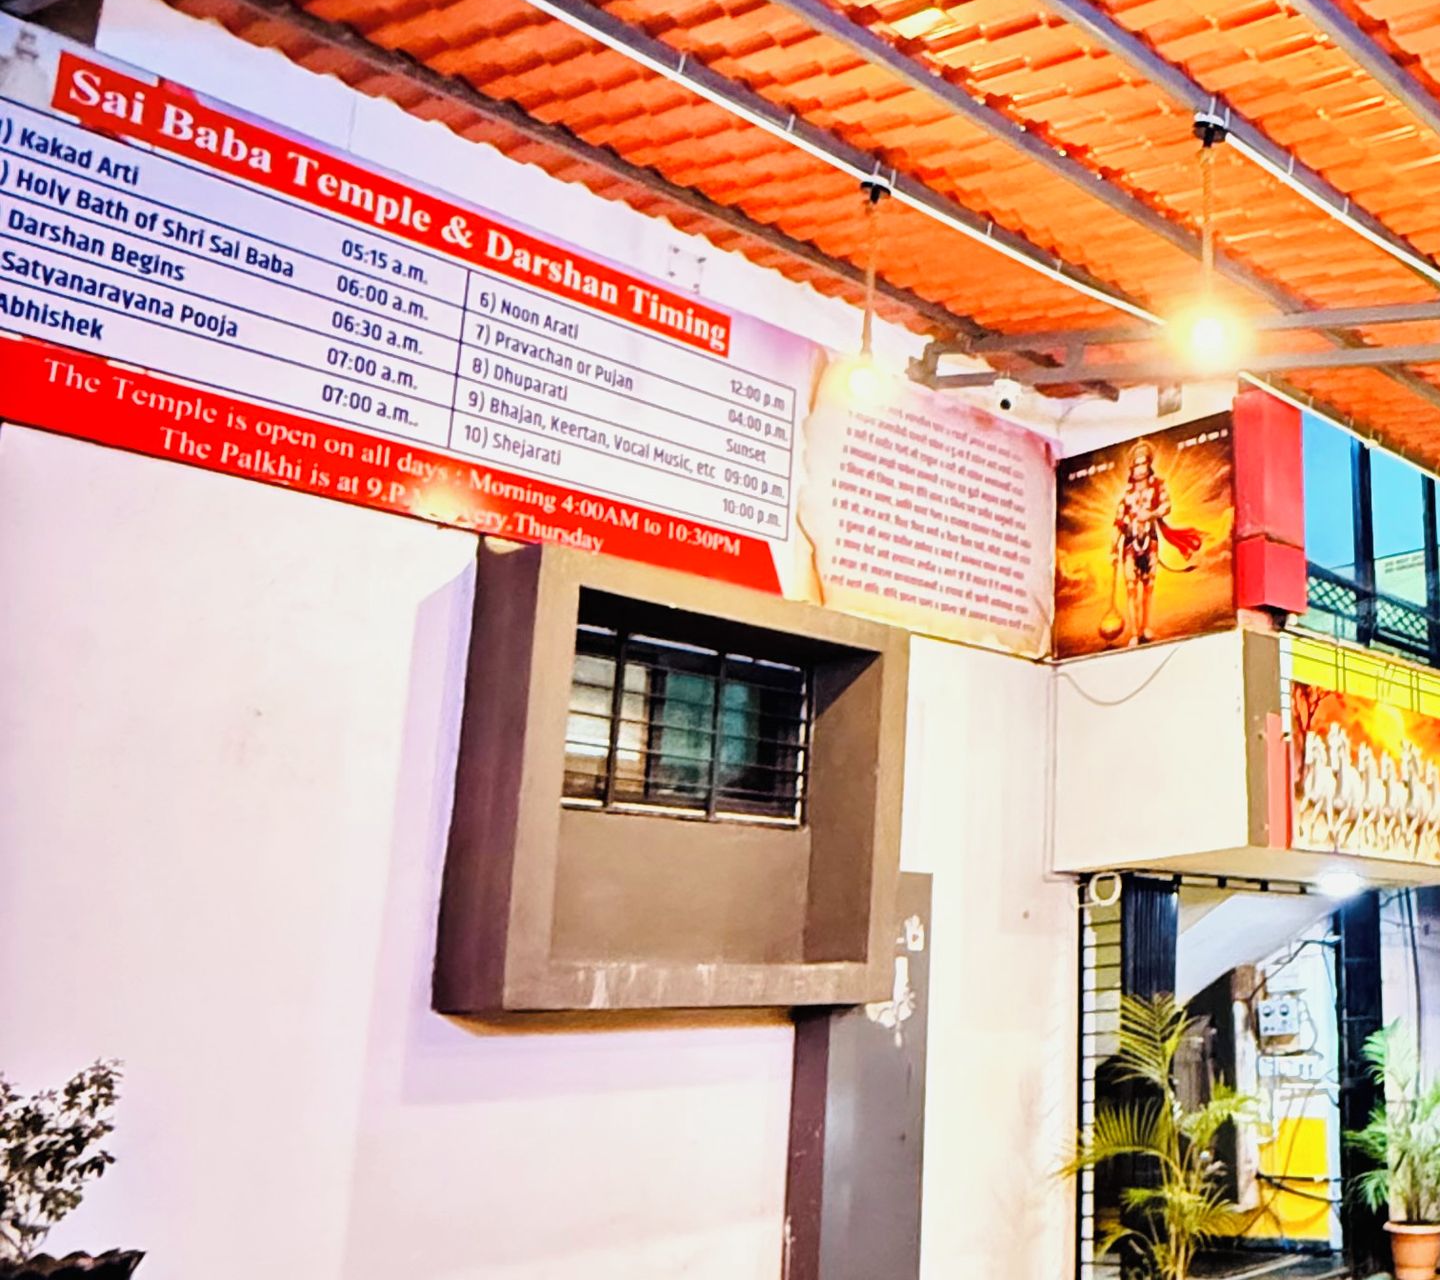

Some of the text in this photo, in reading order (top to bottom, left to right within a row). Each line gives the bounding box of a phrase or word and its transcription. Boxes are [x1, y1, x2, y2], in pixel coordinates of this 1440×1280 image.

[16, 168, 71, 206] Holy
[76, 189, 129, 223] Bath
[135, 209, 159, 232] of
[163, 219, 205, 248] Shri
[210, 234, 241, 261] Sai
[245, 248, 295, 278] Baba
[336, 274, 388, 306] 06:00
[392, 298, 429, 320] a.m.
[20, 127, 92, 170] Kakad
[97, 156, 140, 186] Arti
[341, 239, 388, 270] 05:15
[391, 261, 429, 284] a.m.
[70, 69, 726, 352] Sai Baba Temple & Darshan Timing
[1, 250, 418, 390] Satyanarayana Pooja 07:00 a.m.
[8, 208, 423, 354] Darshan Begins 06:30 a.m.
[0, 292, 104, 341] Abhishek
[322, 384, 373, 413] 07:00
[475, 323, 788, 442] 7) Pravachan or Pujan 04:00 p.m.
[479, 292, 496, 316] 6)
[500, 298, 540, 327] Noon
[543, 315, 580, 340] Arati
[729, 379, 762, 403] 12:00
[44, 357, 101, 394] The
[112, 375, 218, 423] Temple
[226, 405, 248, 432] is
[255, 420, 317, 450] open
[323, 438, 355, 459] on
[360, 444, 391, 468] all
[396, 451, 449, 483] days
[469, 468, 557, 514] Morning
[560, 496, 640, 531] 4:00AM
[643, 517, 662, 536] to
[668, 521, 742, 557] 10:30PM
[160, 425, 212, 460] The
[219, 441, 303, 481] Palkhi
[309, 462, 331, 488] is
[336, 475, 360, 495] at
[467, 390, 785, 500] 9) Bhajan, Keertan, Vocal Music, etc 09:00 p.m.
[472, 357, 767, 465] 8) Dhuparati Sunset
[464, 424, 782, 528] 10) Shejarati 10:00 p.m.
